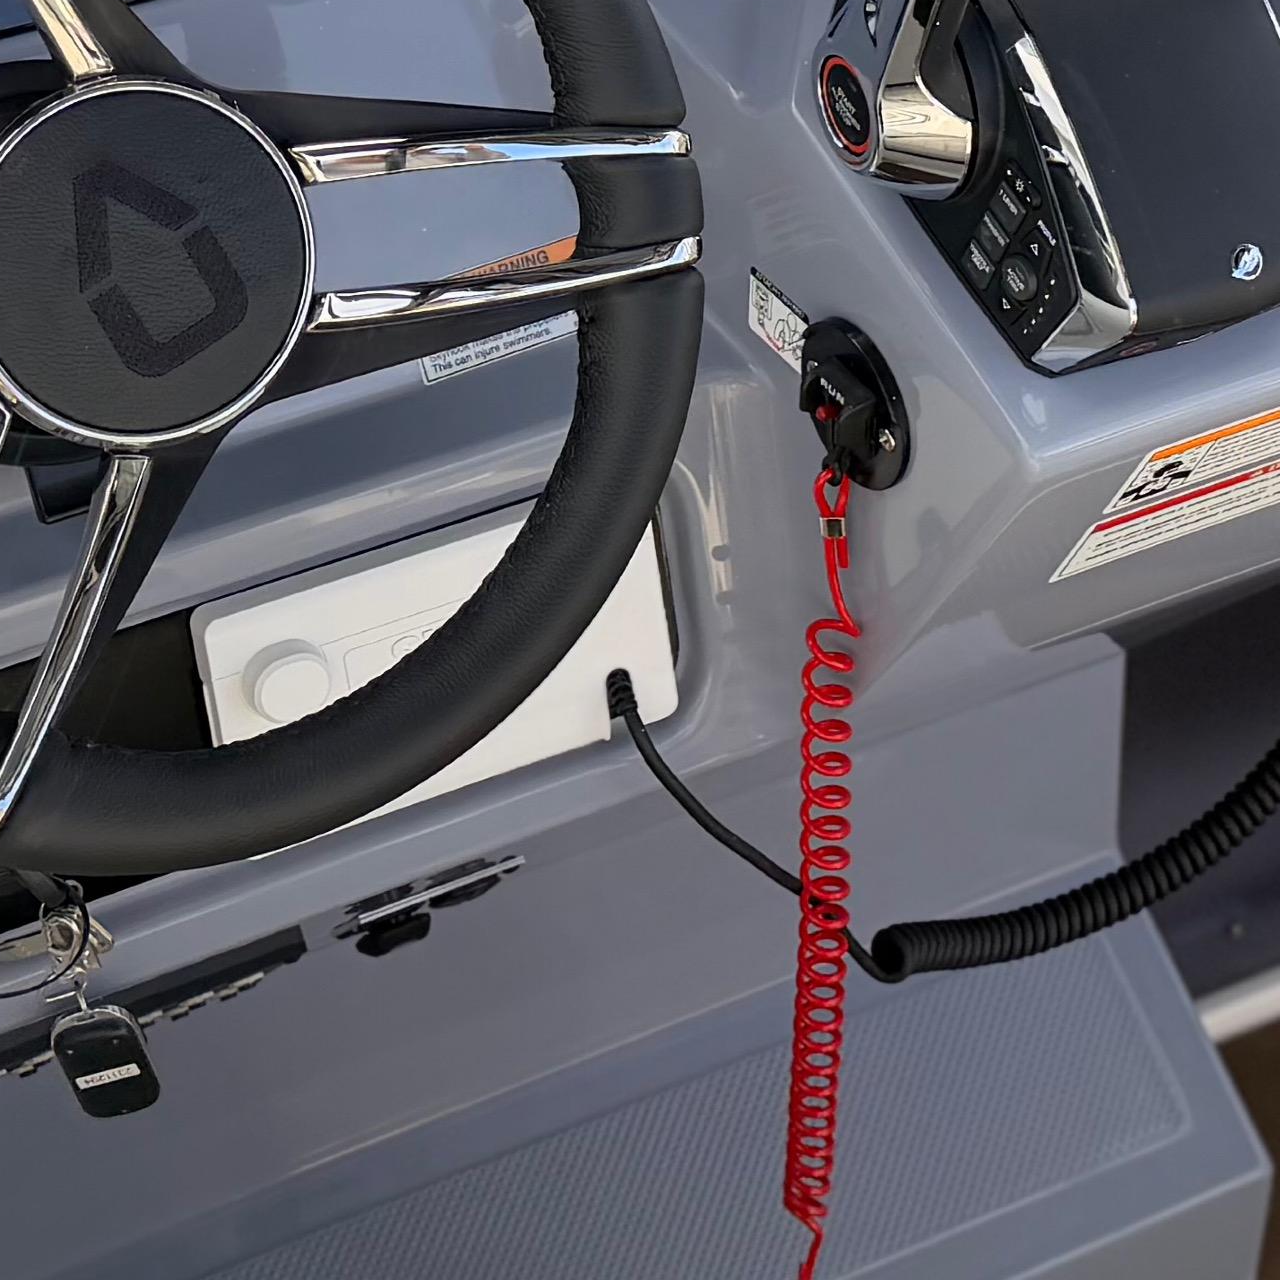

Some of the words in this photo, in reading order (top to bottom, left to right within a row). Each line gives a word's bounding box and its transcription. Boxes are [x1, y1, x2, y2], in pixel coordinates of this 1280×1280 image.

[431, 361, 453, 374] This
[454, 354, 473, 368] can
[475, 343, 501, 360] injure
[820, 377, 845, 406] RUN
